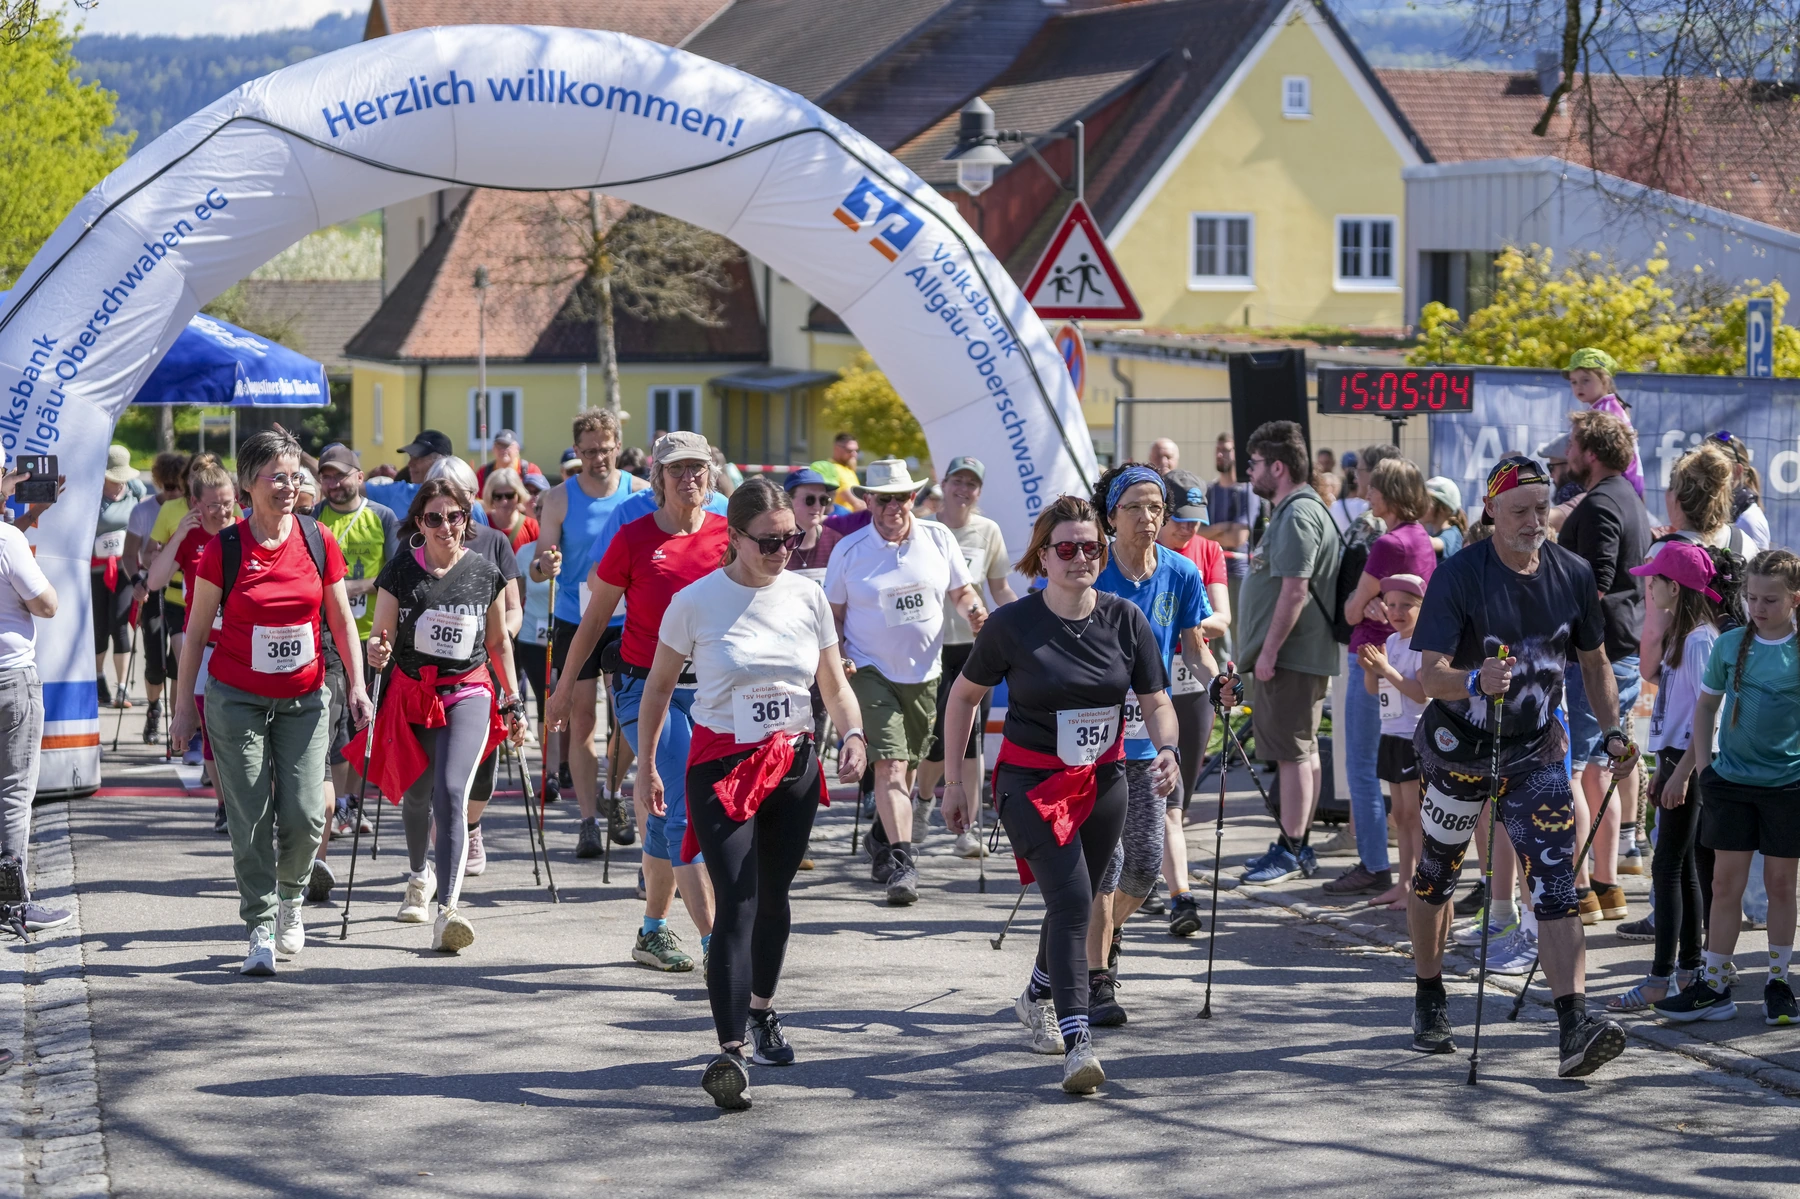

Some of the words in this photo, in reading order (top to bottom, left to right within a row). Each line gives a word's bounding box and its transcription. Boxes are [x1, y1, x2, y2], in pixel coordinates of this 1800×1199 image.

[322, 70, 476, 138] Herzlich
[486, 68, 745, 147] willkommen!
[932, 242, 1021, 358] Volksbank
[24, 216, 194, 456] llgäu-Oberschwaben
[194, 187, 229, 221] eG
[1750, 311, 1766, 376] P
[1340, 372, 1470, 410] 15:05:04
[102, 538, 120, 549] 353
[896, 593, 924, 611] 468
[430, 624, 463, 644] 365
[267, 640, 302, 658] 369
[752, 697, 790, 723] 361
[1077, 710, 1111, 718] Leiblachlauf
[1076, 724, 1110, 747] 354
[1422, 797, 1480, 832] 20869
